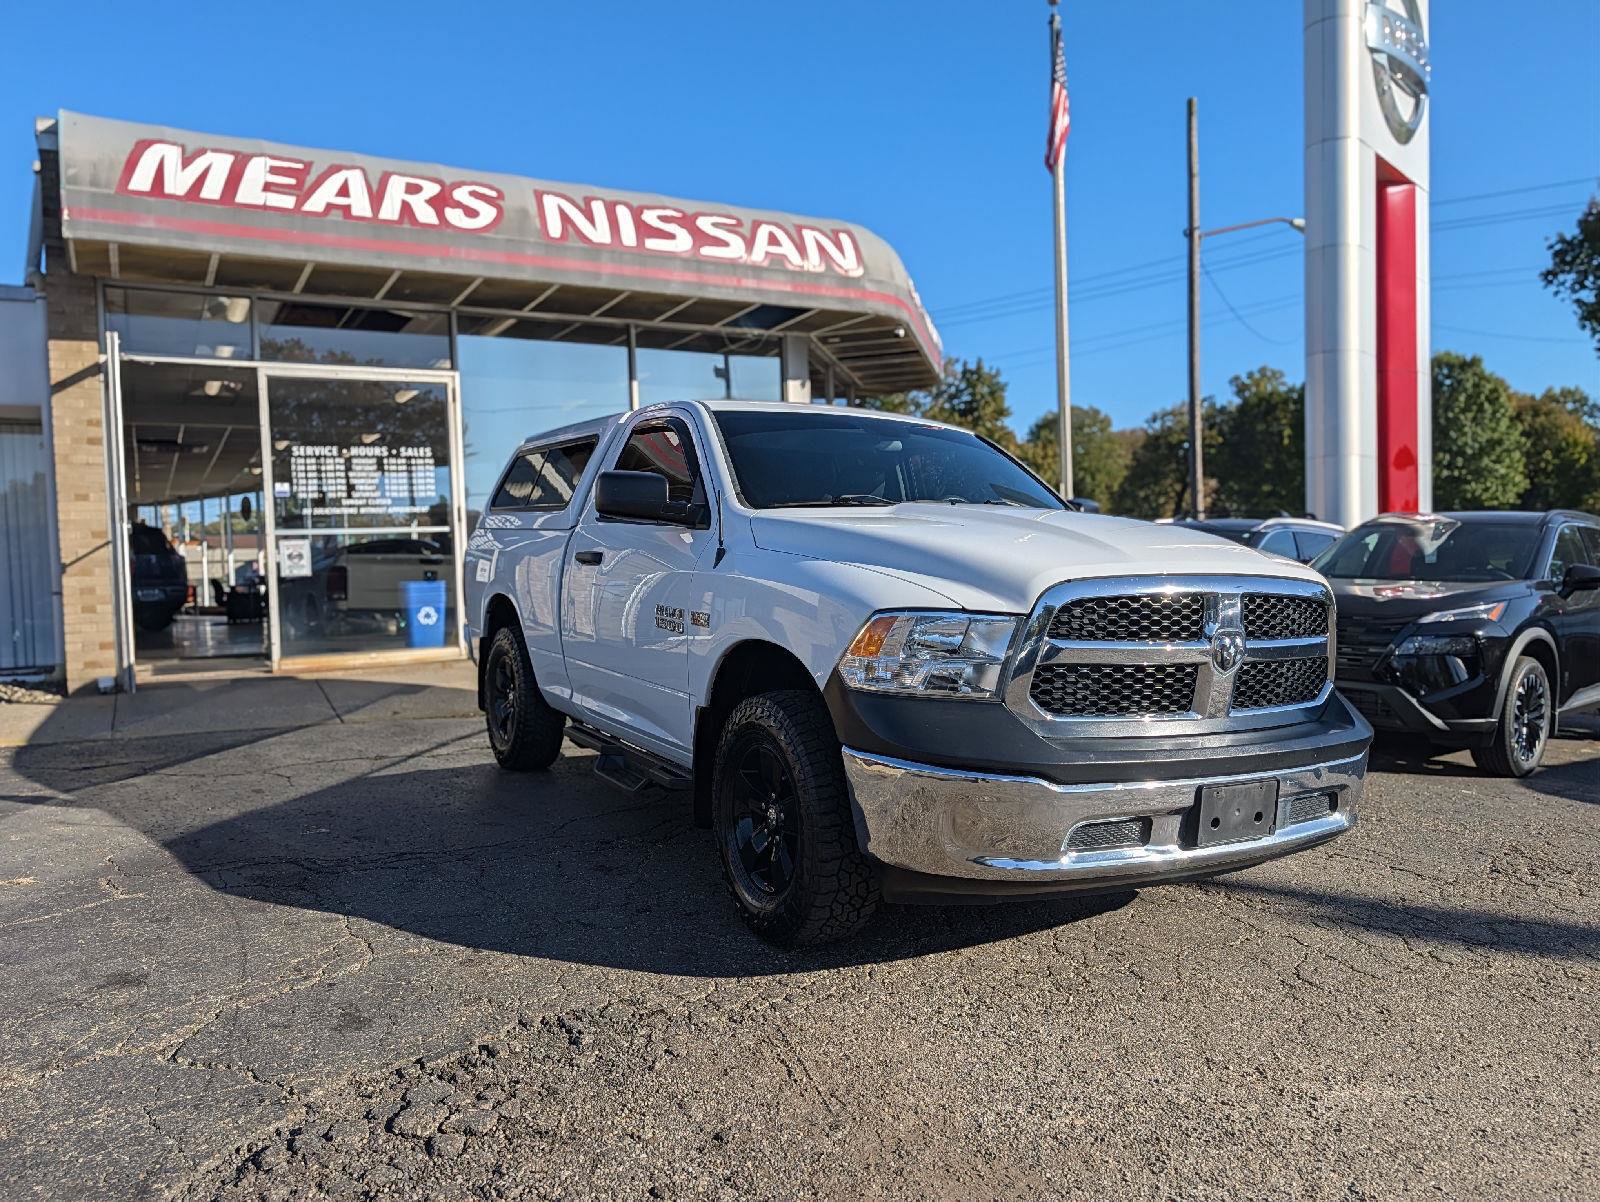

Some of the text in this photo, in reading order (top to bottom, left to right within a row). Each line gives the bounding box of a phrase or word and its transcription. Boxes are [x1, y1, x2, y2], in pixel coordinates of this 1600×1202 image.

[124, 142, 865, 277] MEARS NISSAN
[291, 445, 432, 457] SERVICE HOURS SALES
[655, 616, 685, 634] 1500
